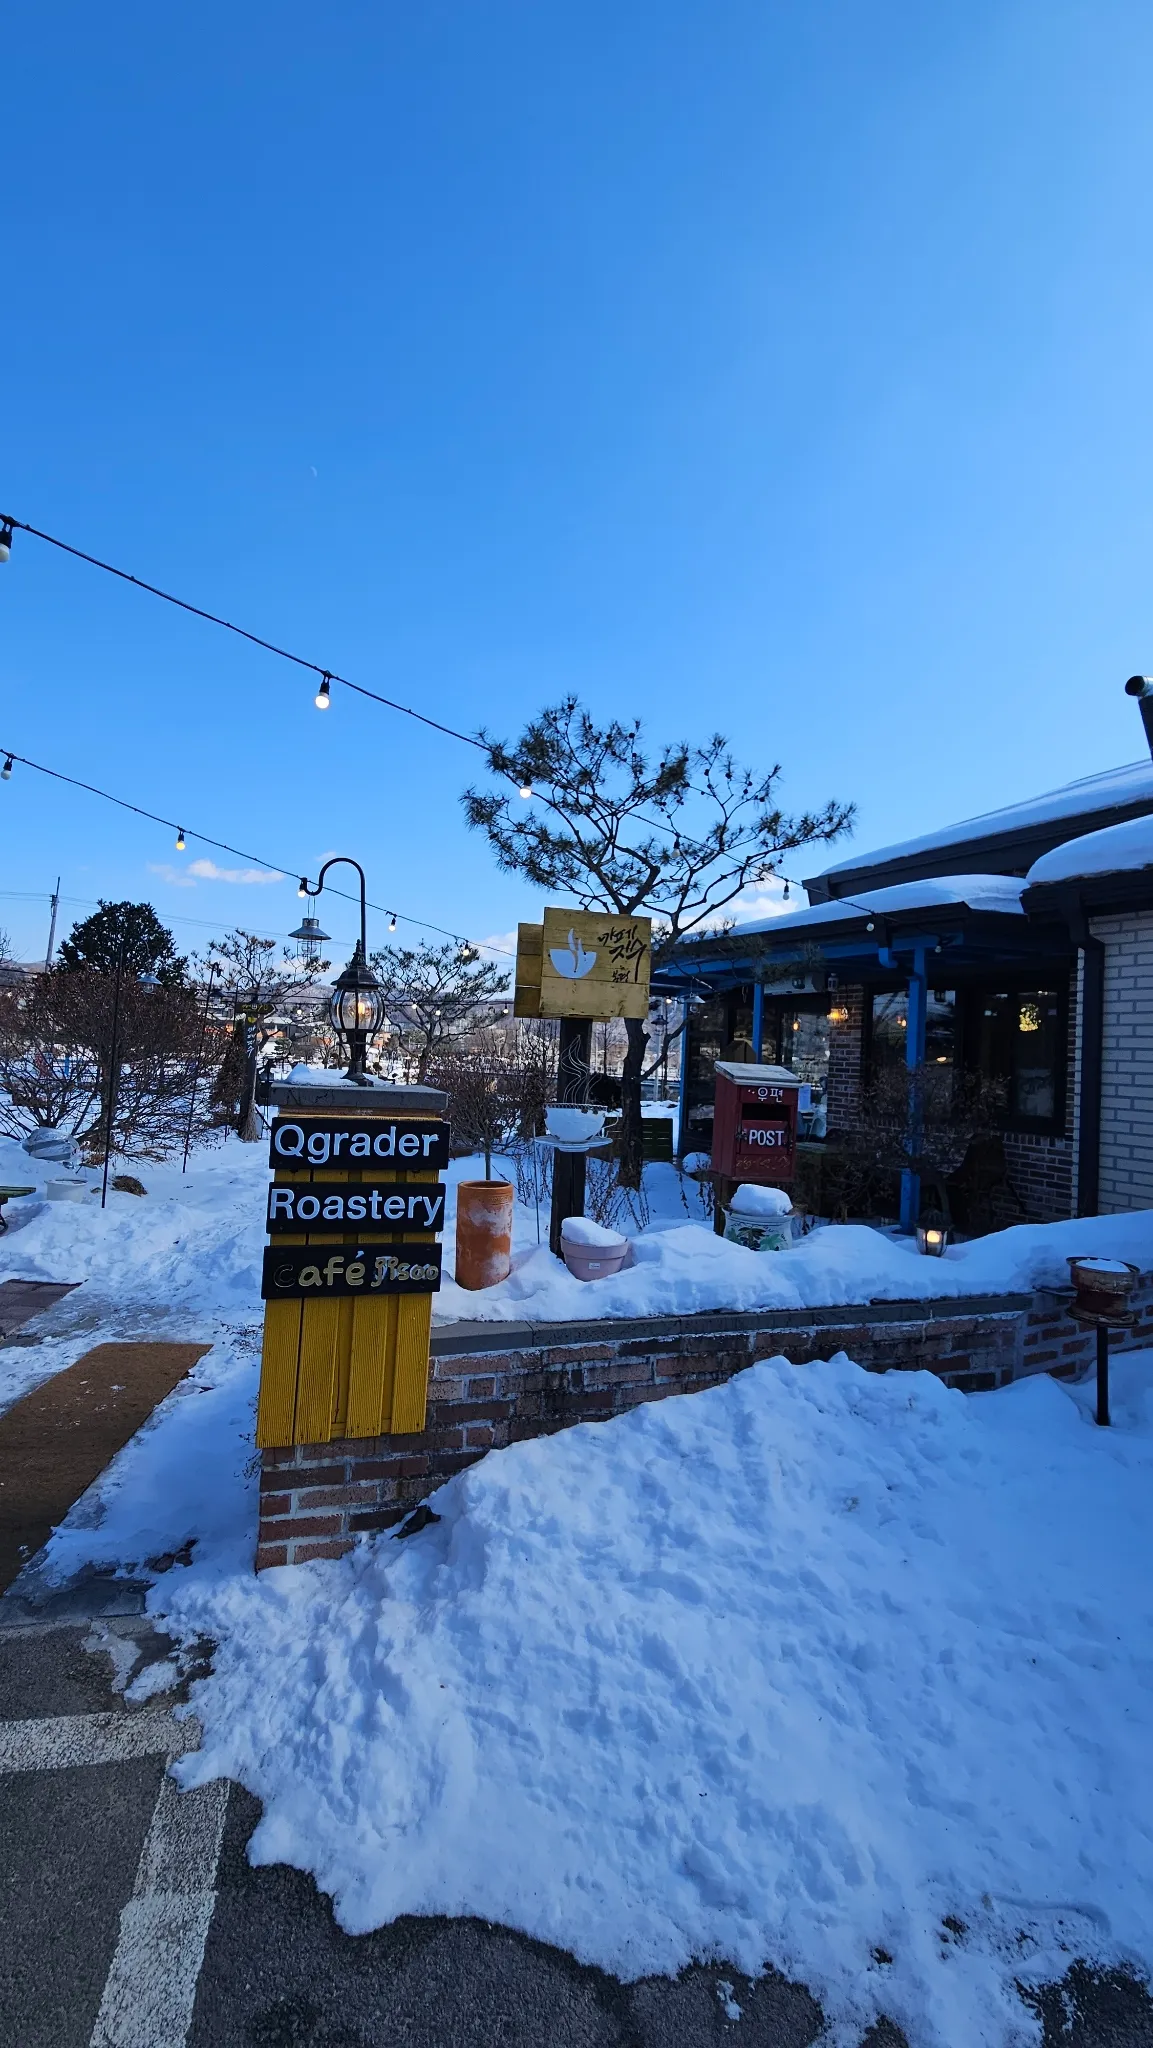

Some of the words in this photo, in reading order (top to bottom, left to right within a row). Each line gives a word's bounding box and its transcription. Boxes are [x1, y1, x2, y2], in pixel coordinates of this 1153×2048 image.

[758, 1087, 783, 1103] 우편
[274, 1124, 440, 1164] Qgrader
[748, 1129, 785, 1146] POST
[269, 1188, 443, 1227] Roastery
